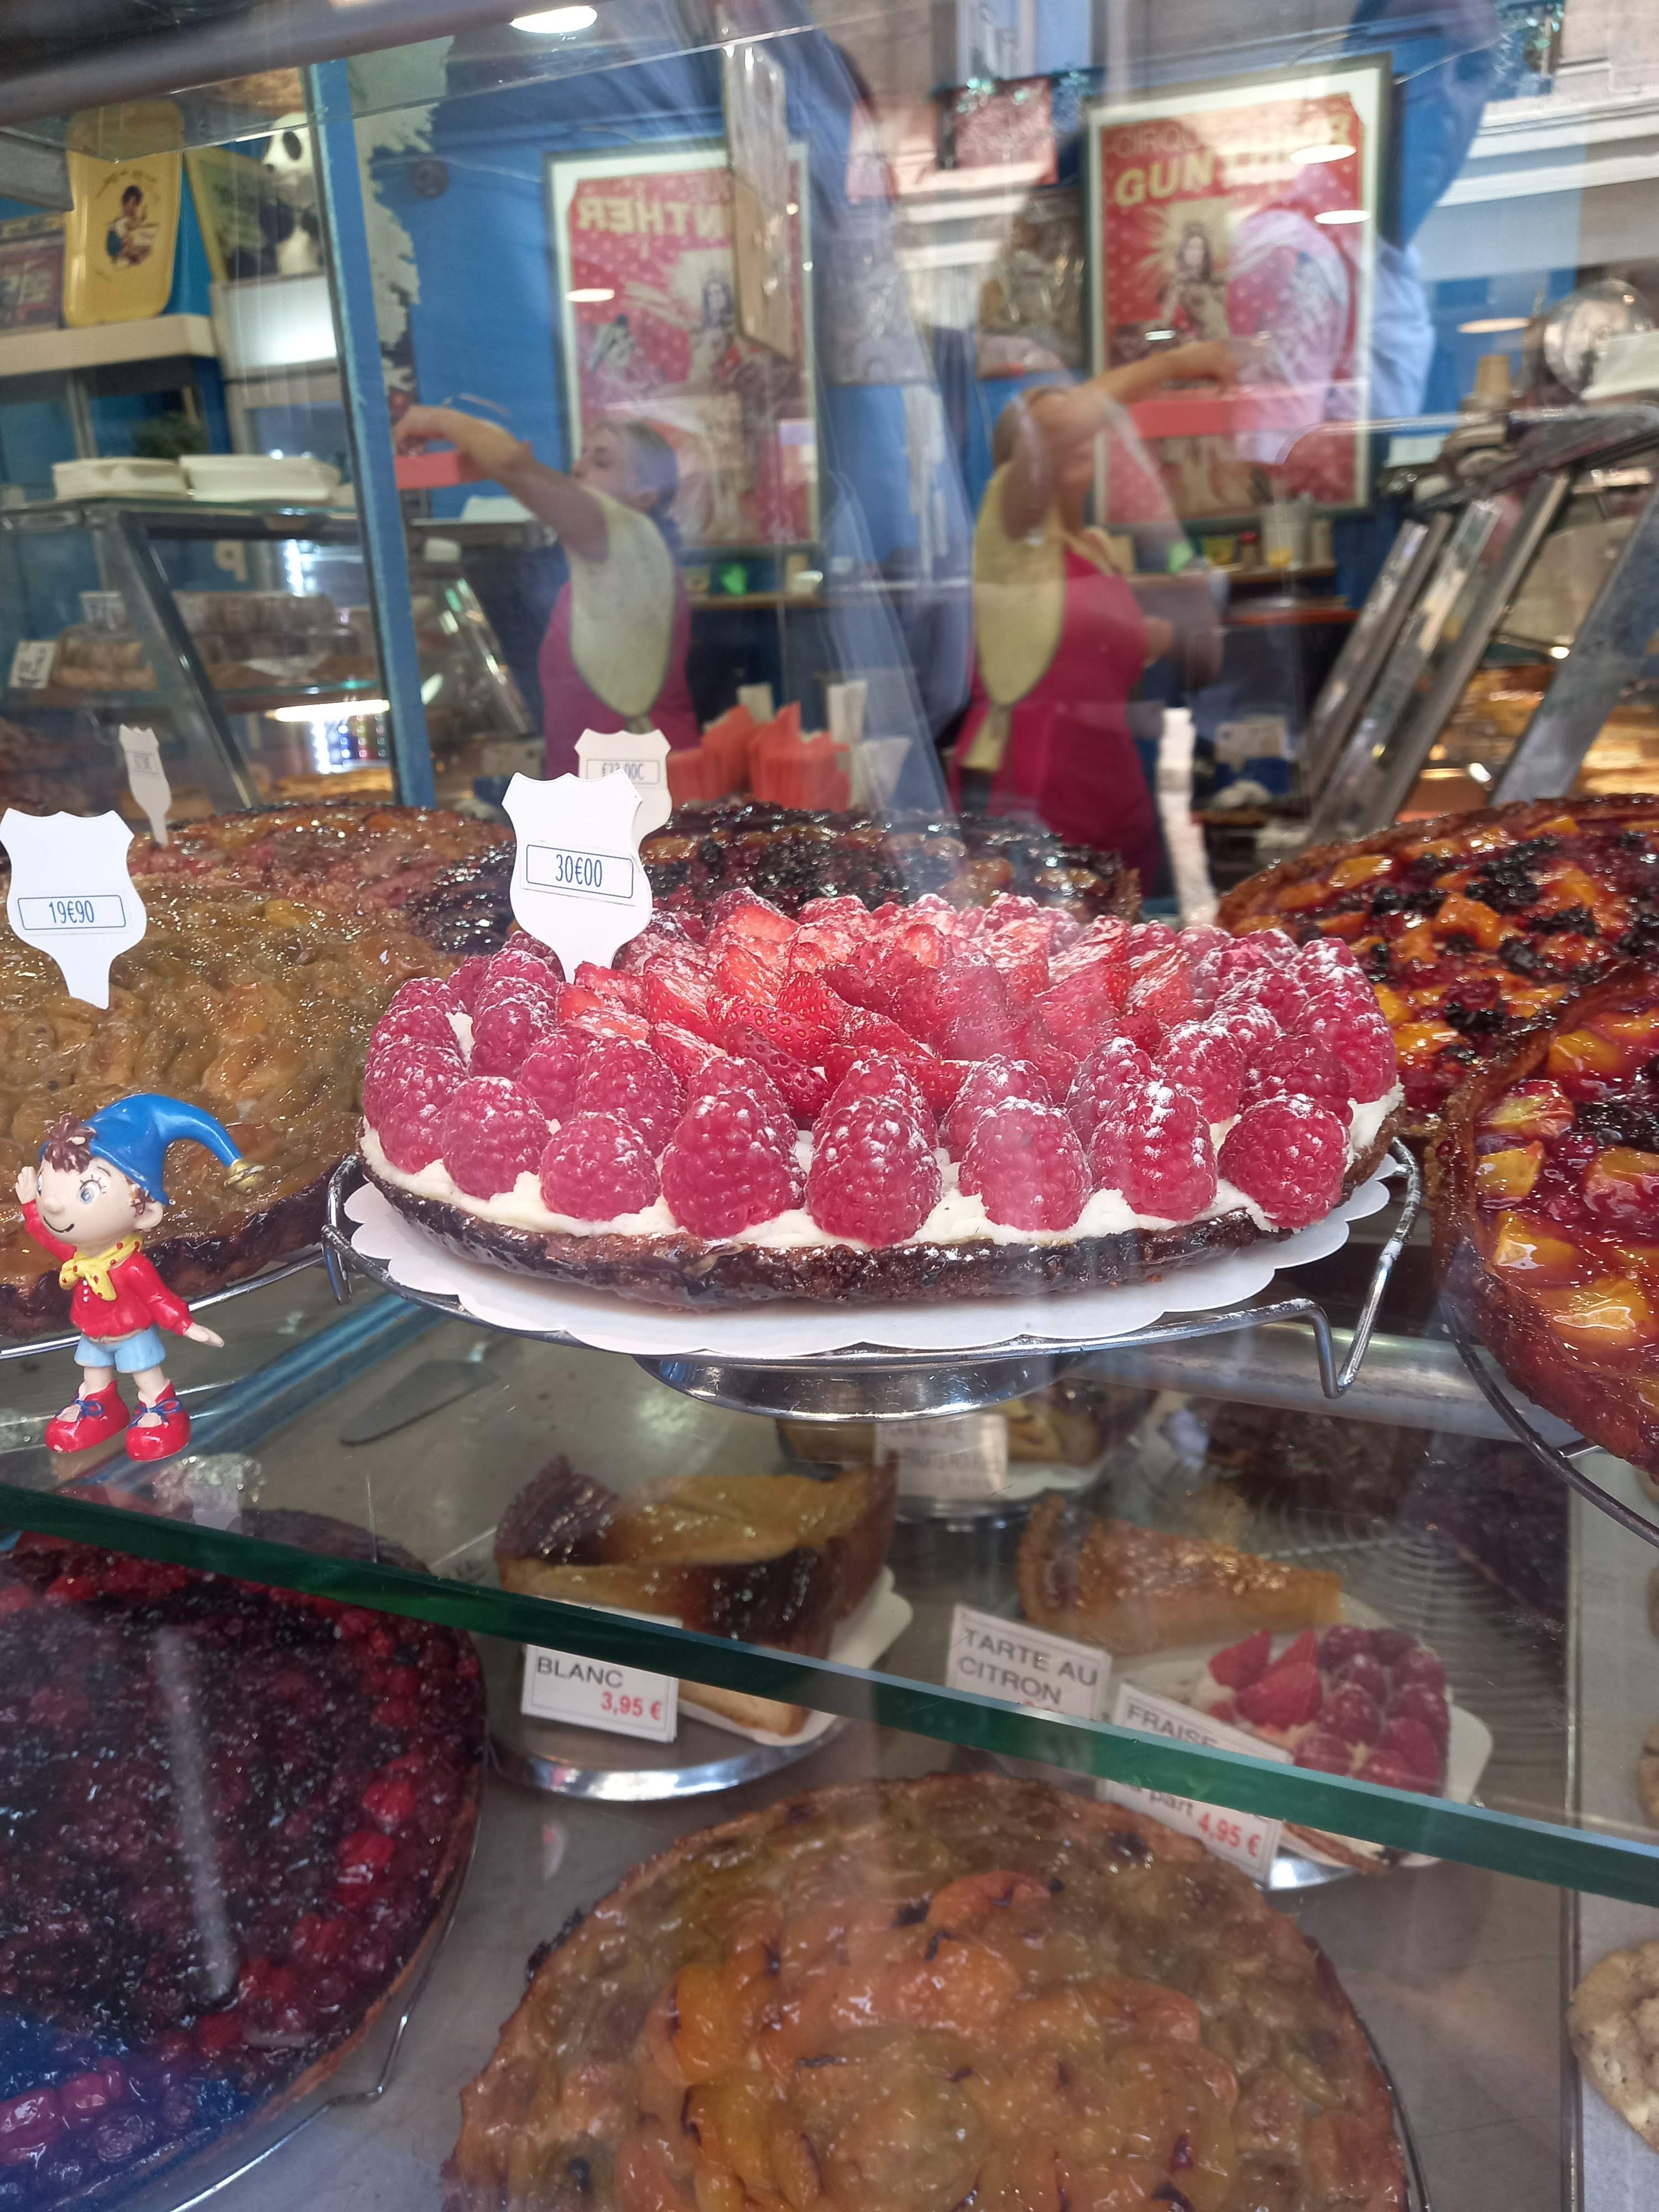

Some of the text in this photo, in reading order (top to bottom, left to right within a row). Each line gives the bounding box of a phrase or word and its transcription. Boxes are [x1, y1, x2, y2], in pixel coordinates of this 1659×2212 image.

[555, 854, 603, 888] 30€00
[48, 900, 95, 924] 19€90
[536, 1656, 624, 1689] BLANC
[966, 1627, 1098, 1687] TARTE AU
[958, 1655, 1063, 1704] CITRON
[601, 1690, 662, 1721] 3,95 €
[1198, 1813, 1261, 1857] 4,95 €
